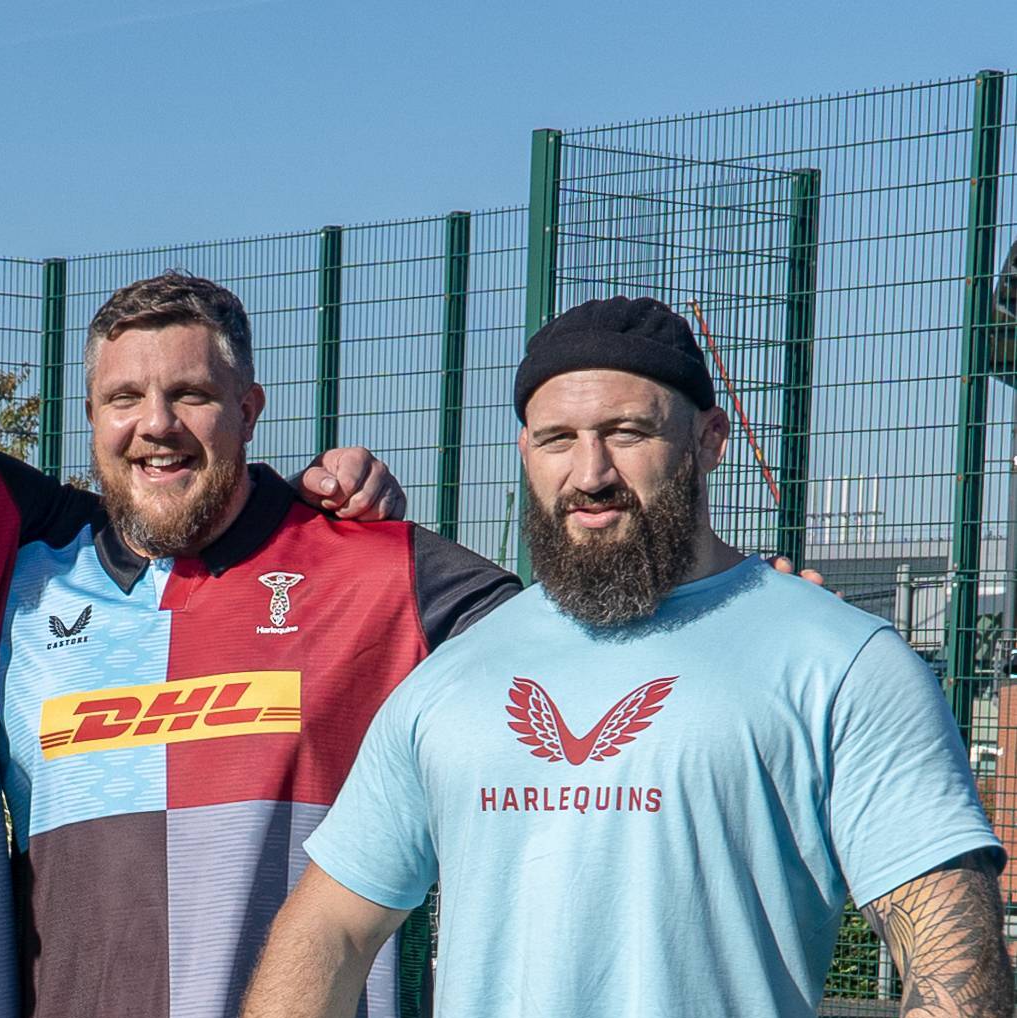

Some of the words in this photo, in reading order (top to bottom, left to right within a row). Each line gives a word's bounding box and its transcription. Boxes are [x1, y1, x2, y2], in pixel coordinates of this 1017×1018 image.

[256, 625, 299, 635] Harlequins
[47, 636, 89, 650] CASTORE
[72, 682, 263, 744] DHL
[480, 786, 662, 815] HARLEQUINS
